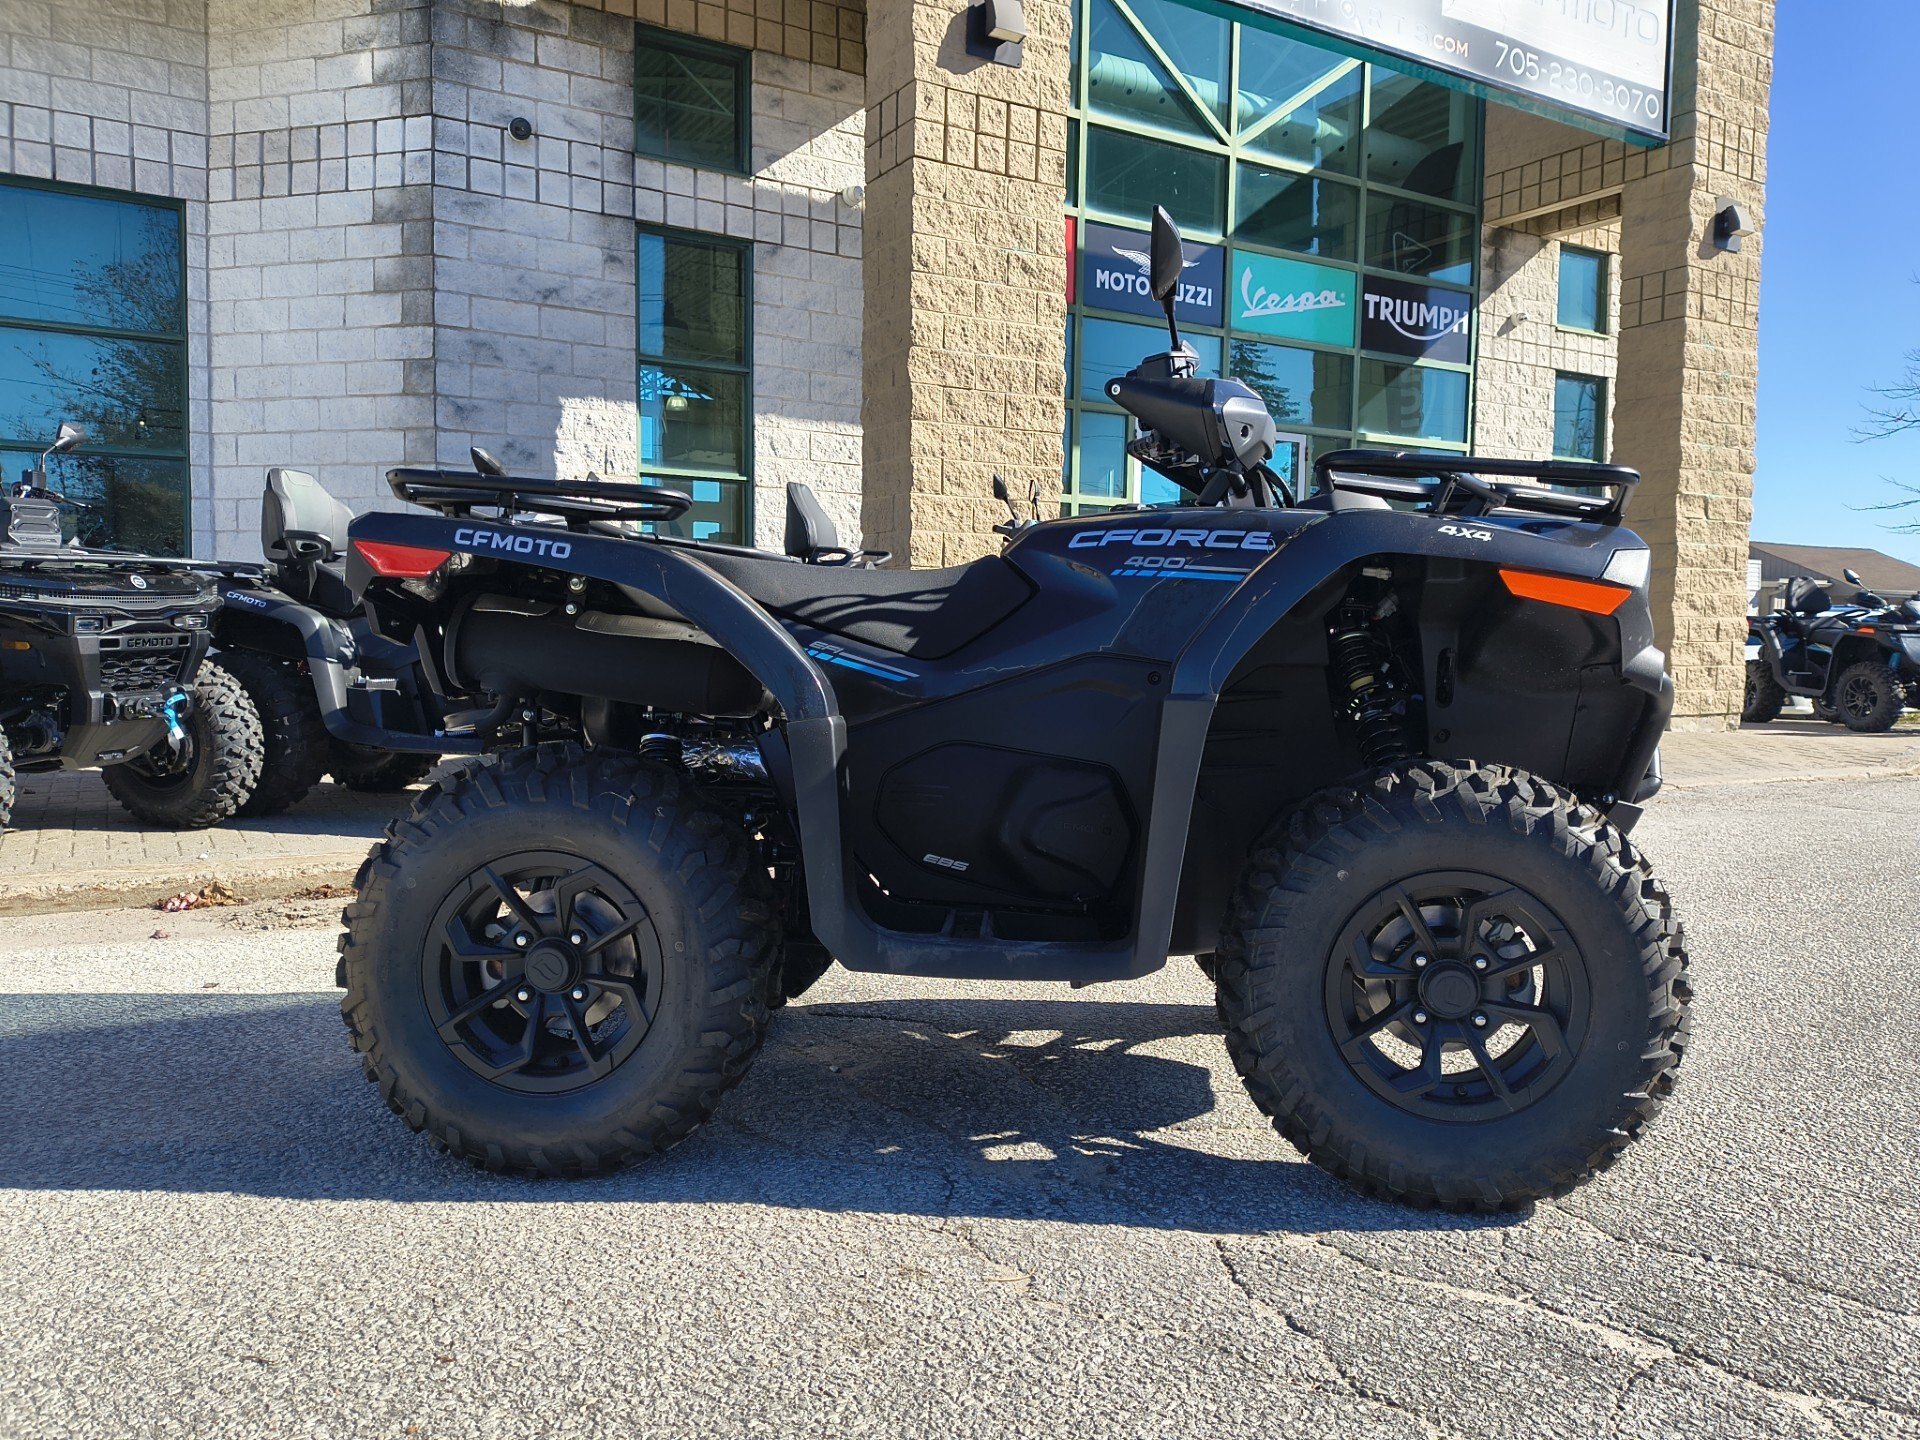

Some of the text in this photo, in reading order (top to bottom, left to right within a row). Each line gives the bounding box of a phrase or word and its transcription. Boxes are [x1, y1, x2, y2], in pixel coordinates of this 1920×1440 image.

[1495, 41, 1660, 119] 705-230-3070
[1096, 268, 1150, 296] MOTO
[1241, 266, 1346, 318] Vespa
[1364, 293, 1469, 340] TRIUMPH
[454, 528, 572, 560] CFMOTO
[1068, 529, 1276, 551] CFORCE
[1124, 556, 1186, 569] 400
[226, 591, 267, 608] CFMOTO
[126, 637, 174, 648] CFMOTO
[808, 641, 844, 654] EFI
[923, 853, 970, 871] EBS
